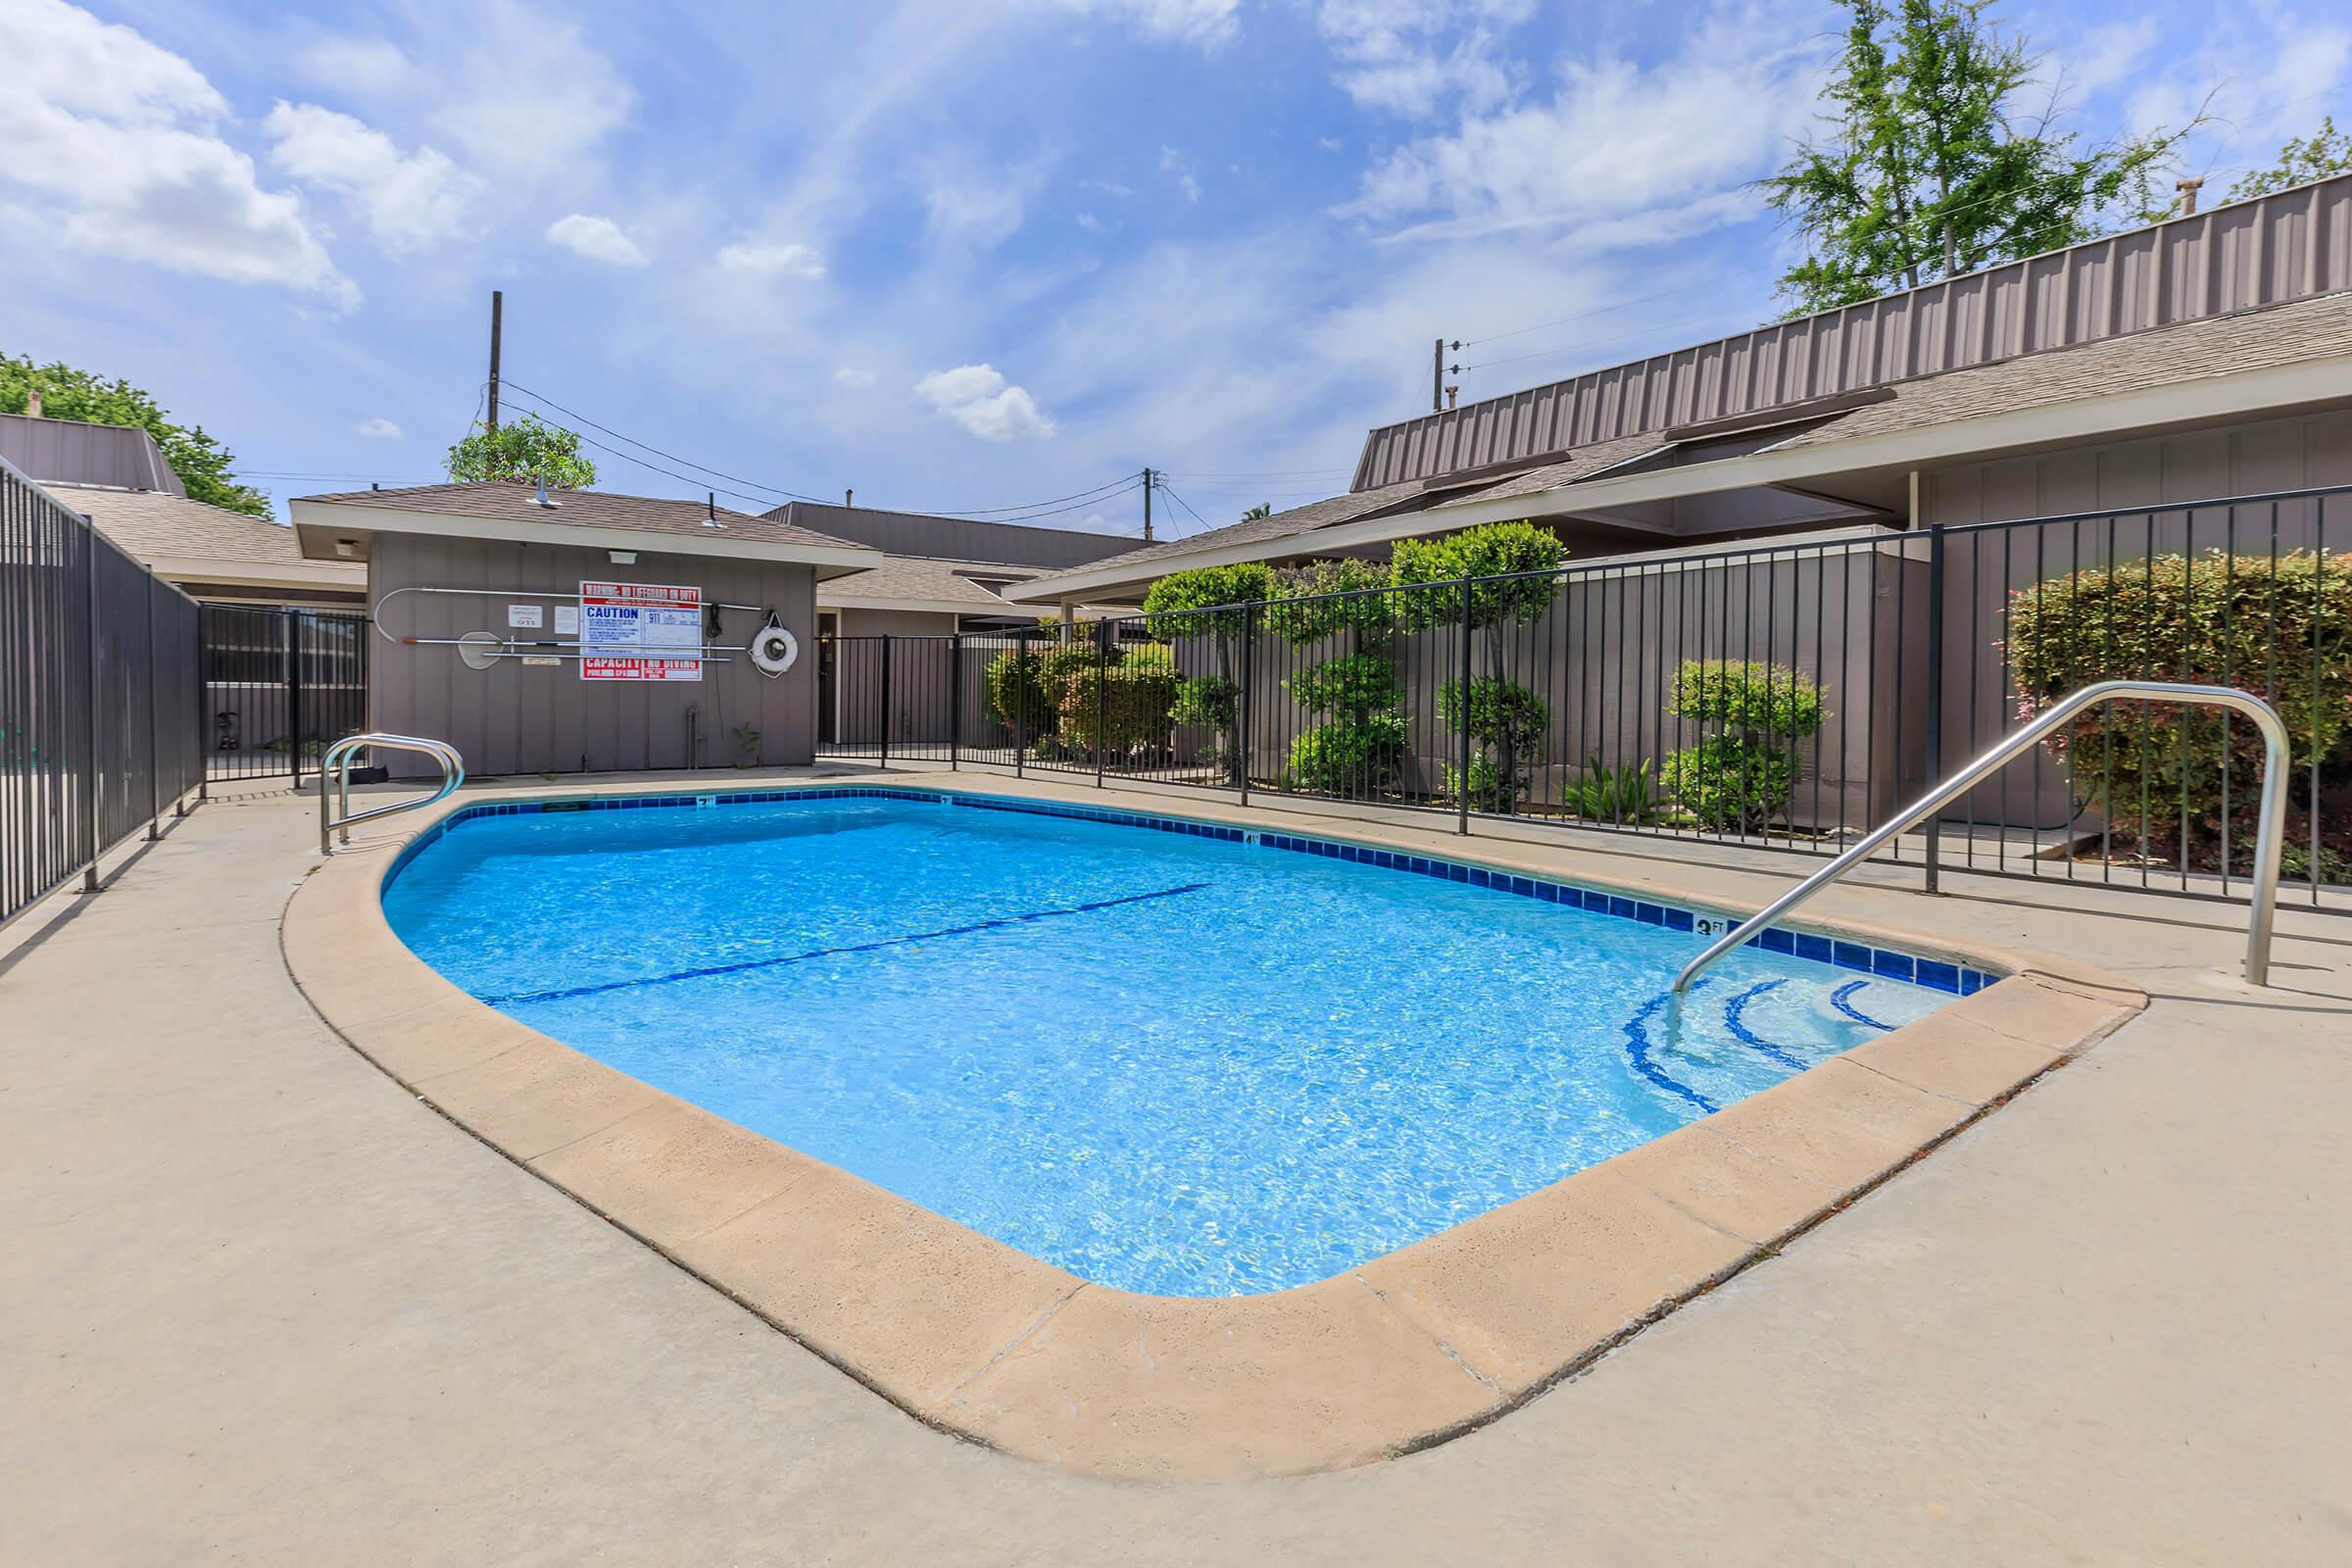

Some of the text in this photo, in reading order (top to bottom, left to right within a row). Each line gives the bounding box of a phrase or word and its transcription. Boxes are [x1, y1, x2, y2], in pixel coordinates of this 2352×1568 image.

[621, 586, 631, 597] NO
[633, 586, 668, 599] LIFEGUARD
[669, 588, 678, 600] ON
[680, 589, 698, 602] DUTY
[587, 607, 639, 618] CAUTION
[649, 612, 661, 624] 911
[586, 658, 640, 668] CAPACITY
[648, 659, 696, 669] NO DIVING
[1697, 918, 1724, 936] 3 FT
